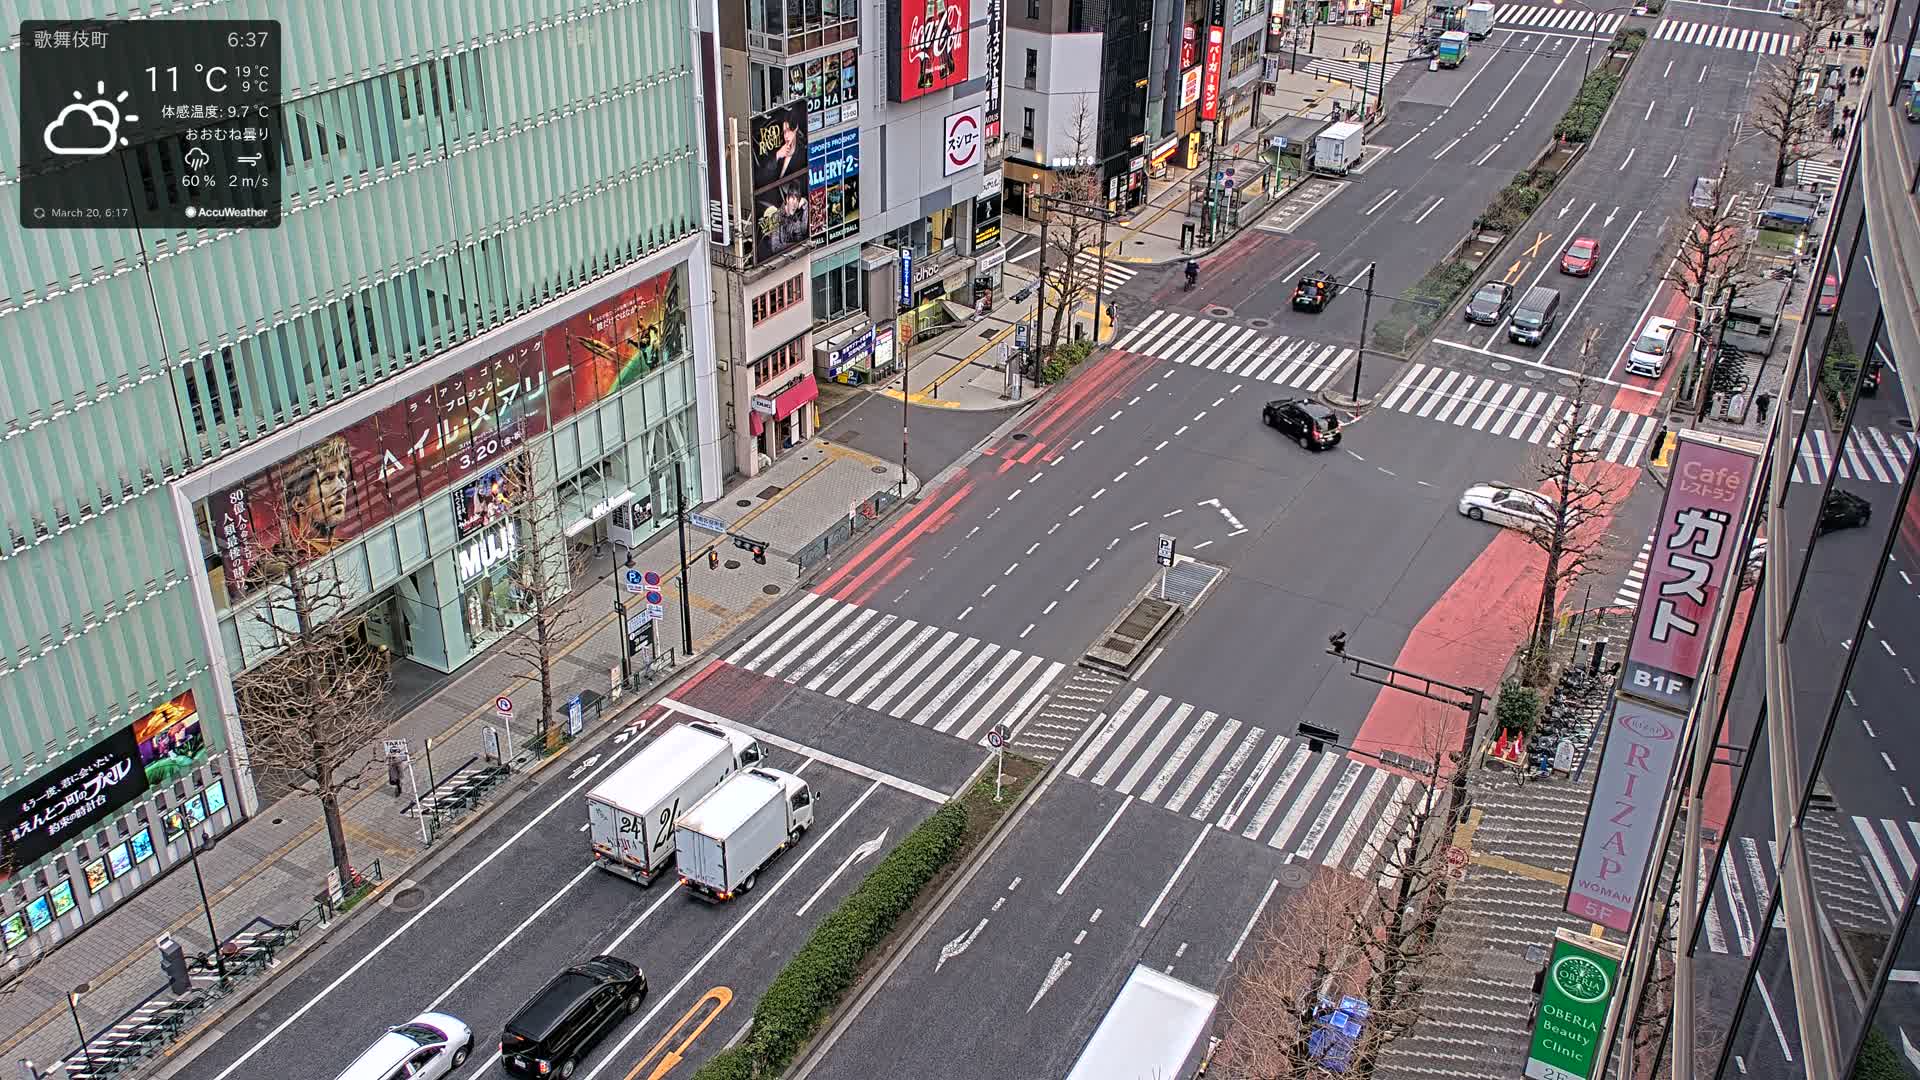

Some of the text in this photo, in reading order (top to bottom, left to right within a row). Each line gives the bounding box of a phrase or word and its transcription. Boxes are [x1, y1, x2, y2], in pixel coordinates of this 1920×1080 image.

[1206, 45, 1219, 110] バーガーキング
[947, 133, 979, 152] スシロー
[710, 200, 722, 233] MUJI
[409, 341, 542, 412] ライアン・ゴスリング
[446, 377, 503, 412] プロジェクト
[460, 440, 498, 470] 3.20
[1683, 461, 1741, 490] Café
[1680, 480, 1736, 502] レストラン
[459, 522, 518, 581] MUJI
[1650, 509, 1731, 643] ガスト
[1633, 669, 1684, 695] B1F
[22, 754, 114, 812] もう一度、君に会いたい
[20, 758, 131, 838] えんとつ町のプペル
[1596, 742, 1651, 881] RIZAP
[48, 794, 106, 836] 約束の時計台
[620, 816, 640, 839] 24
[1578, 880, 1632, 904] WOMAN
[1585, 904, 1613, 921] 5F
[1560, 970, 1600, 991] OBERIA
[1543, 1004, 1597, 1032] OBERIA
[1543, 1020, 1590, 1046] Beauty
[1542, 1039, 1583, 1061] Clinic
